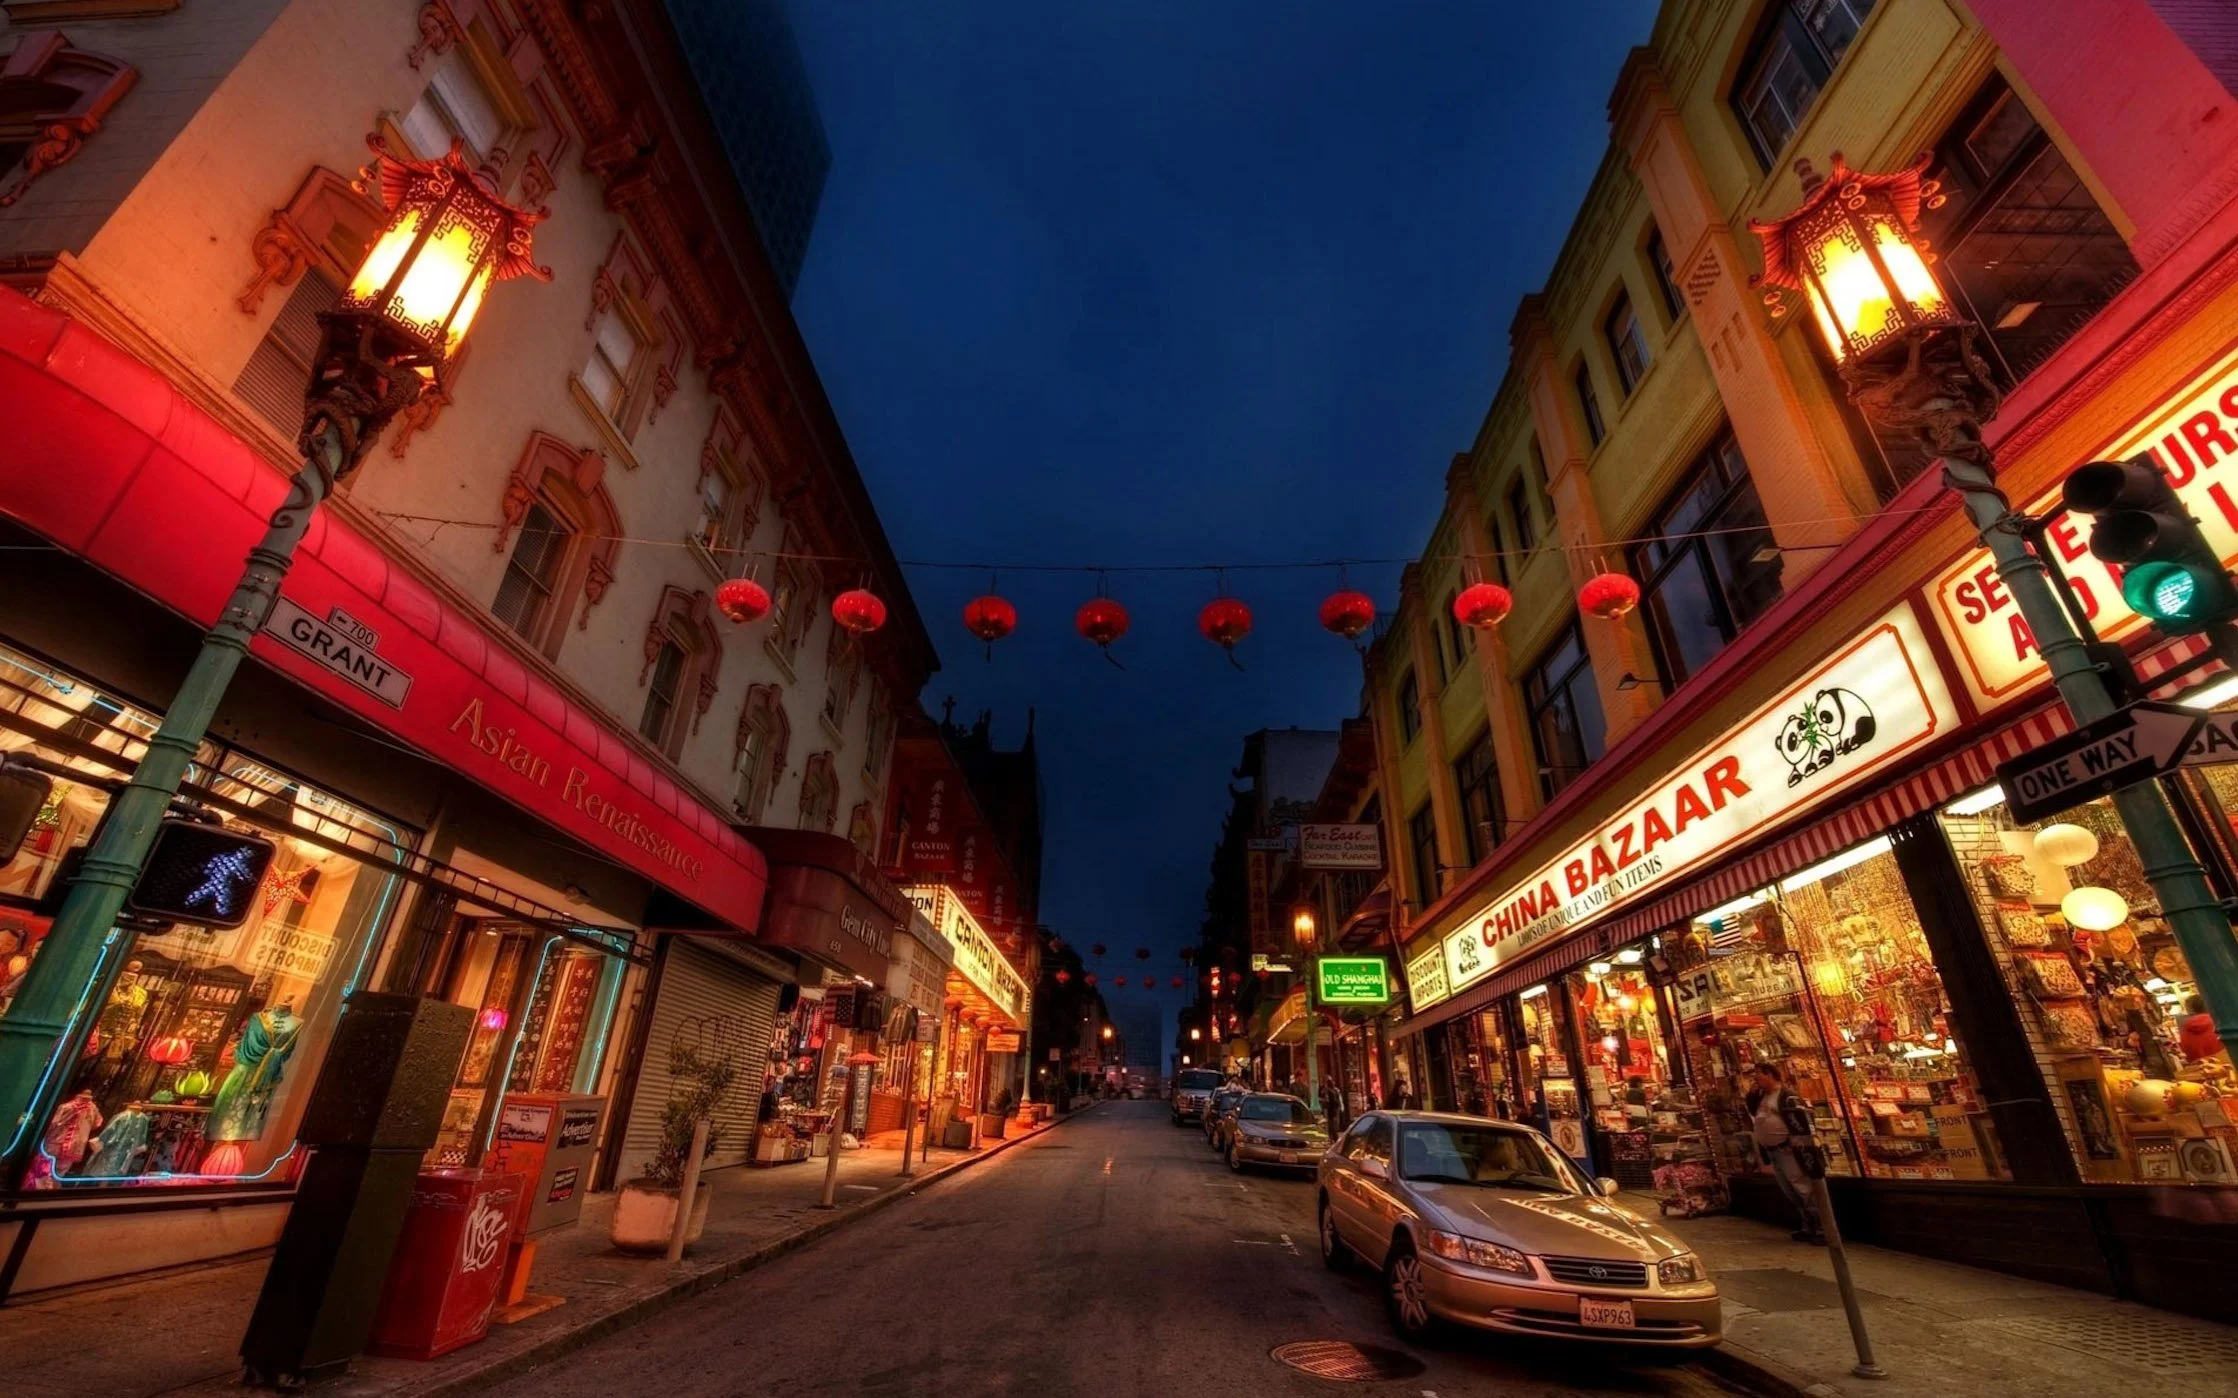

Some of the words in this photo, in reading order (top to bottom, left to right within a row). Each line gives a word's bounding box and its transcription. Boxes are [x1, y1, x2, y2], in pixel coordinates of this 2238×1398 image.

[350, 620, 374, 645] 700
[291, 618, 391, 687] GRANT
[2021, 760, 2078, 799] ONE
[2080, 729, 2139, 775] WAY
[450, 697, 550, 788] Asian
[561, 766, 704, 882] Renaissance
[912, 841, 950, 851] CANTON
[1329, 827, 1361, 841] East
[1482, 880, 1560, 948] CHINA
[1564, 755, 1752, 898] BAZAAR
[1547, 901, 1581, 930] UNIQUE
[1583, 888, 1602, 911] AND
[1602, 876, 1626, 902] FUN
[1625, 855, 1663, 888] ITEMS
[860, 919, 877, 955] City
[955, 915, 995, 974] CANTON
[1325, 974, 1341, 985] OLD
[1341, 974, 1383, 985] SHANGHAI
[1410, 953, 1441, 985] DISCOUNT
[1414, 974, 1443, 1004] IMPORTS
[1934, 1115, 1967, 1127] FRONT
[1584, 1307, 1632, 1325] 4SXP963
